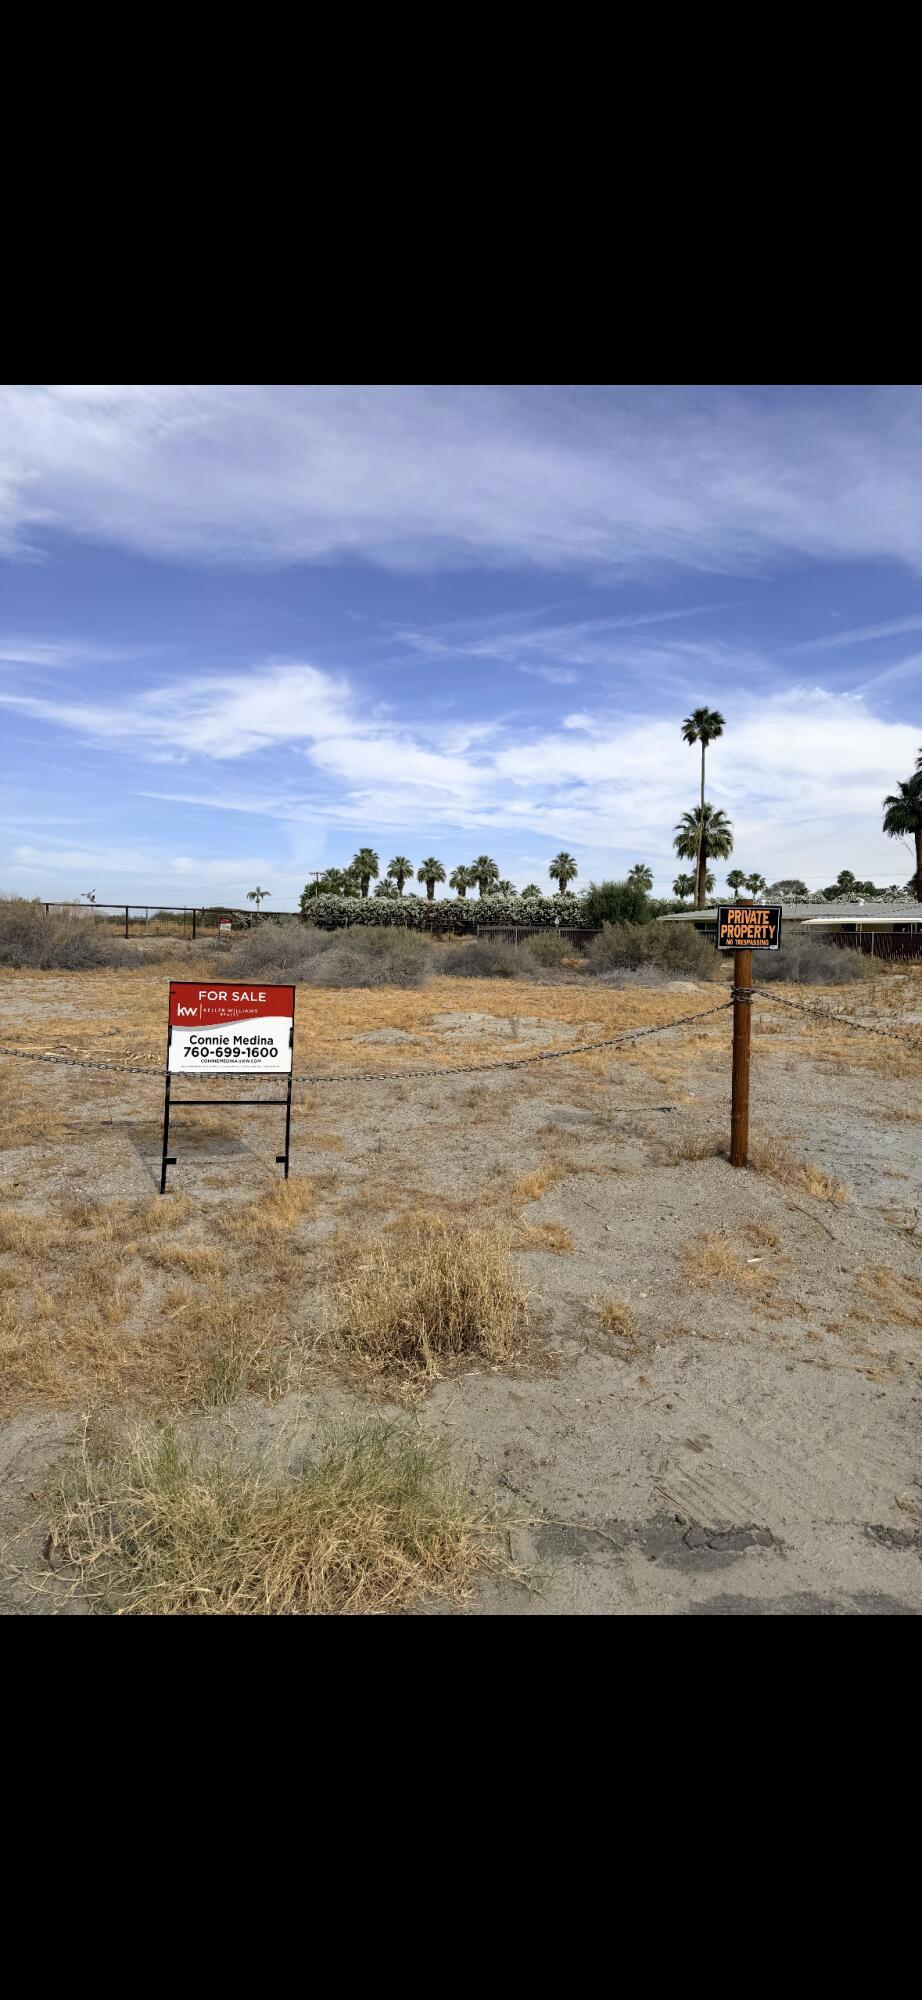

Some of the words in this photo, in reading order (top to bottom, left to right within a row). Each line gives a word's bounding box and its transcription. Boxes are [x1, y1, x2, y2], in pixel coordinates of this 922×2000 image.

[728, 910, 770, 924] PRIVATE
[721, 925, 776, 938] PROPERTY
[199, 991, 227, 1001] FOR
[232, 991, 267, 1002] SALE
[177, 1003, 197, 1016] kw
[189, 1035, 229, 1045] Connie
[233, 1035, 274, 1045] Medina
[183, 1047, 278, 1057] 760-699-1600
